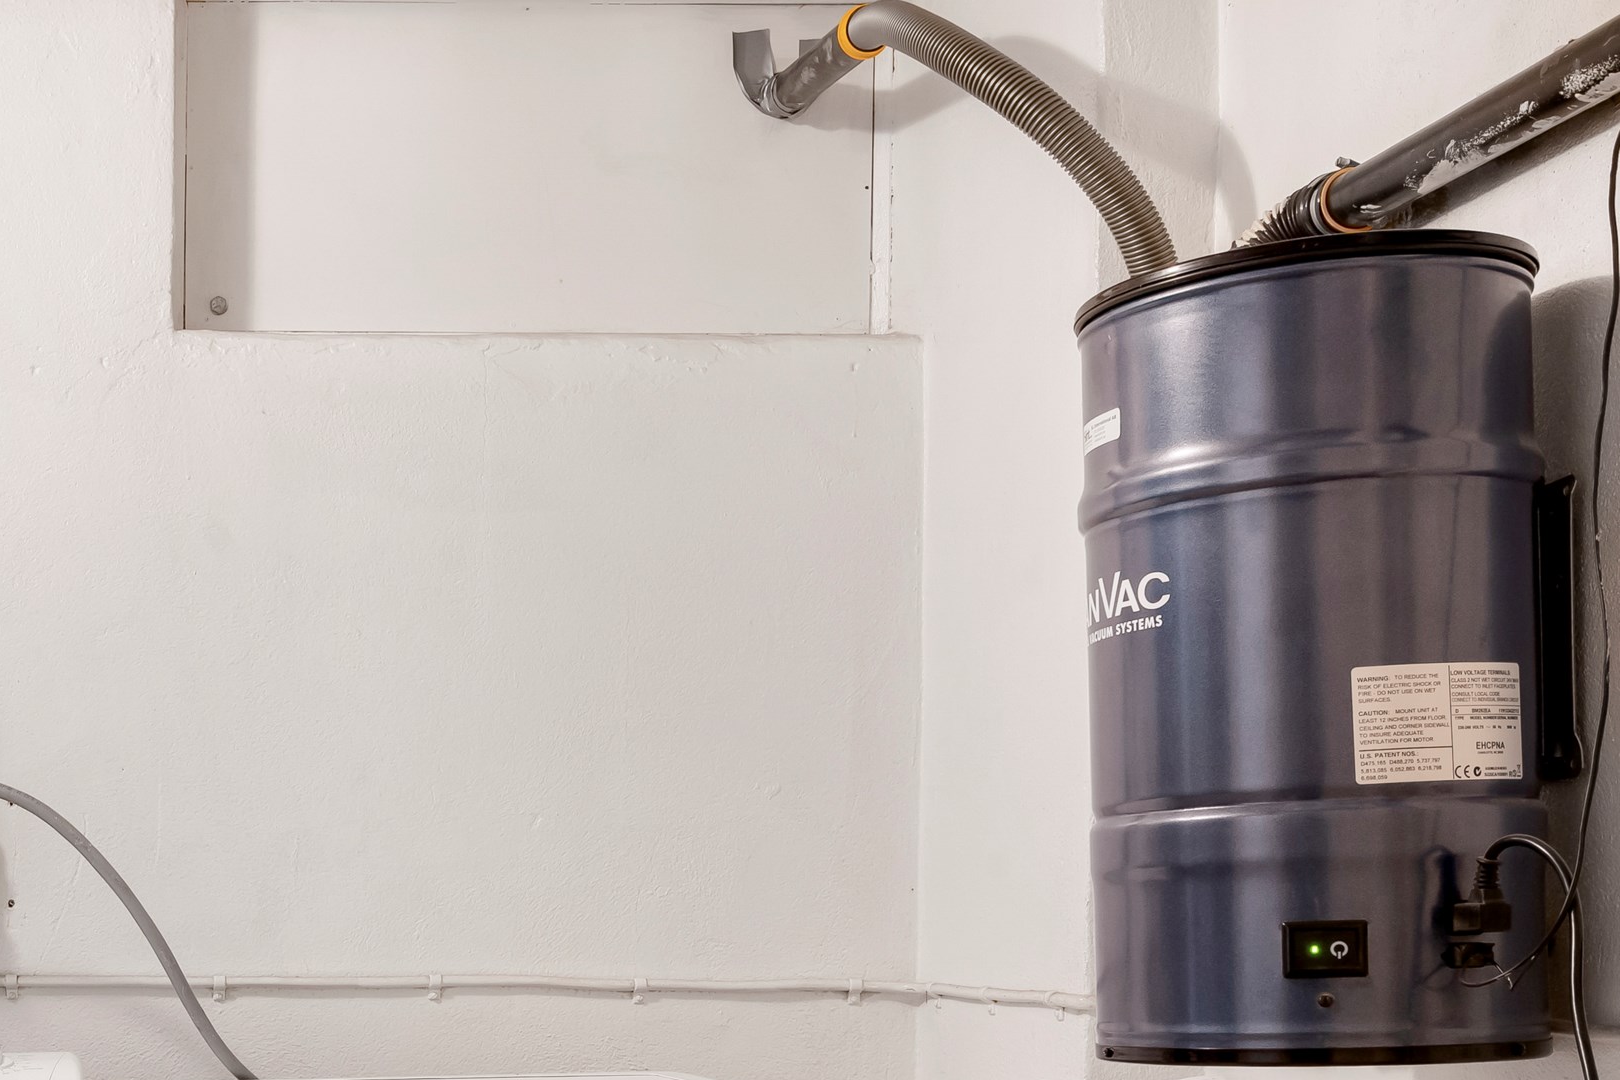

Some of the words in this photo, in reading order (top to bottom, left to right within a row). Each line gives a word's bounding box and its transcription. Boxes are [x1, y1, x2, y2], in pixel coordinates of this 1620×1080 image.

[1087, 570, 1172, 628] NVAC
[1115, 614, 1164, 636] SYSTEMS
[1360, 738, 1399, 746] VENTILATION
[1475, 741, 1506, 750] EHCPNA
